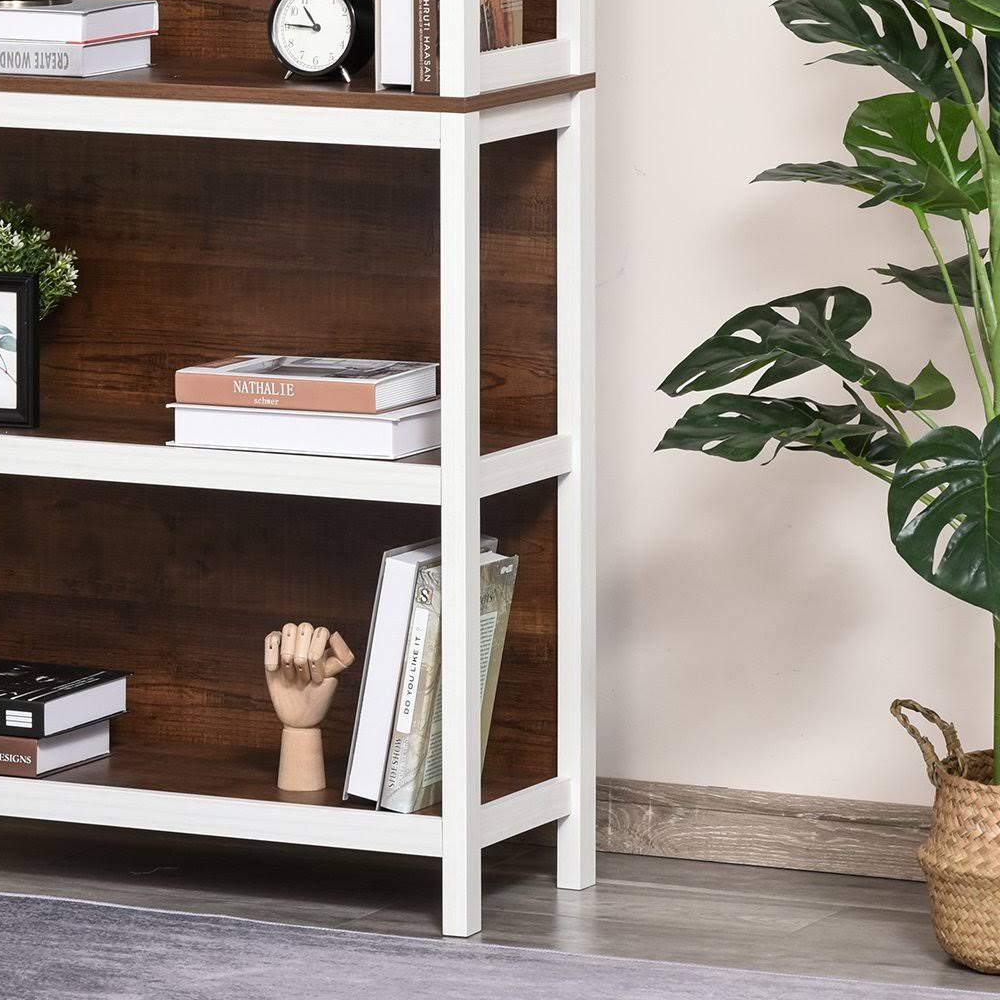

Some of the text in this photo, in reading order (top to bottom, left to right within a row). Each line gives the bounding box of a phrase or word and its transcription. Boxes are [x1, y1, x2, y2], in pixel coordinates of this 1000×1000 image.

[291, 6, 298, 16] 10
[33, 51, 69, 70] CREATE
[423, 36, 431, 82] HAASAN
[233, 380, 295, 397] NATHALIE
[404, 700, 411, 715] DO
[410, 649, 419, 672] LIKE
[415, 637, 421, 646] IT
[387, 738, 401, 789] SIDESHOW
